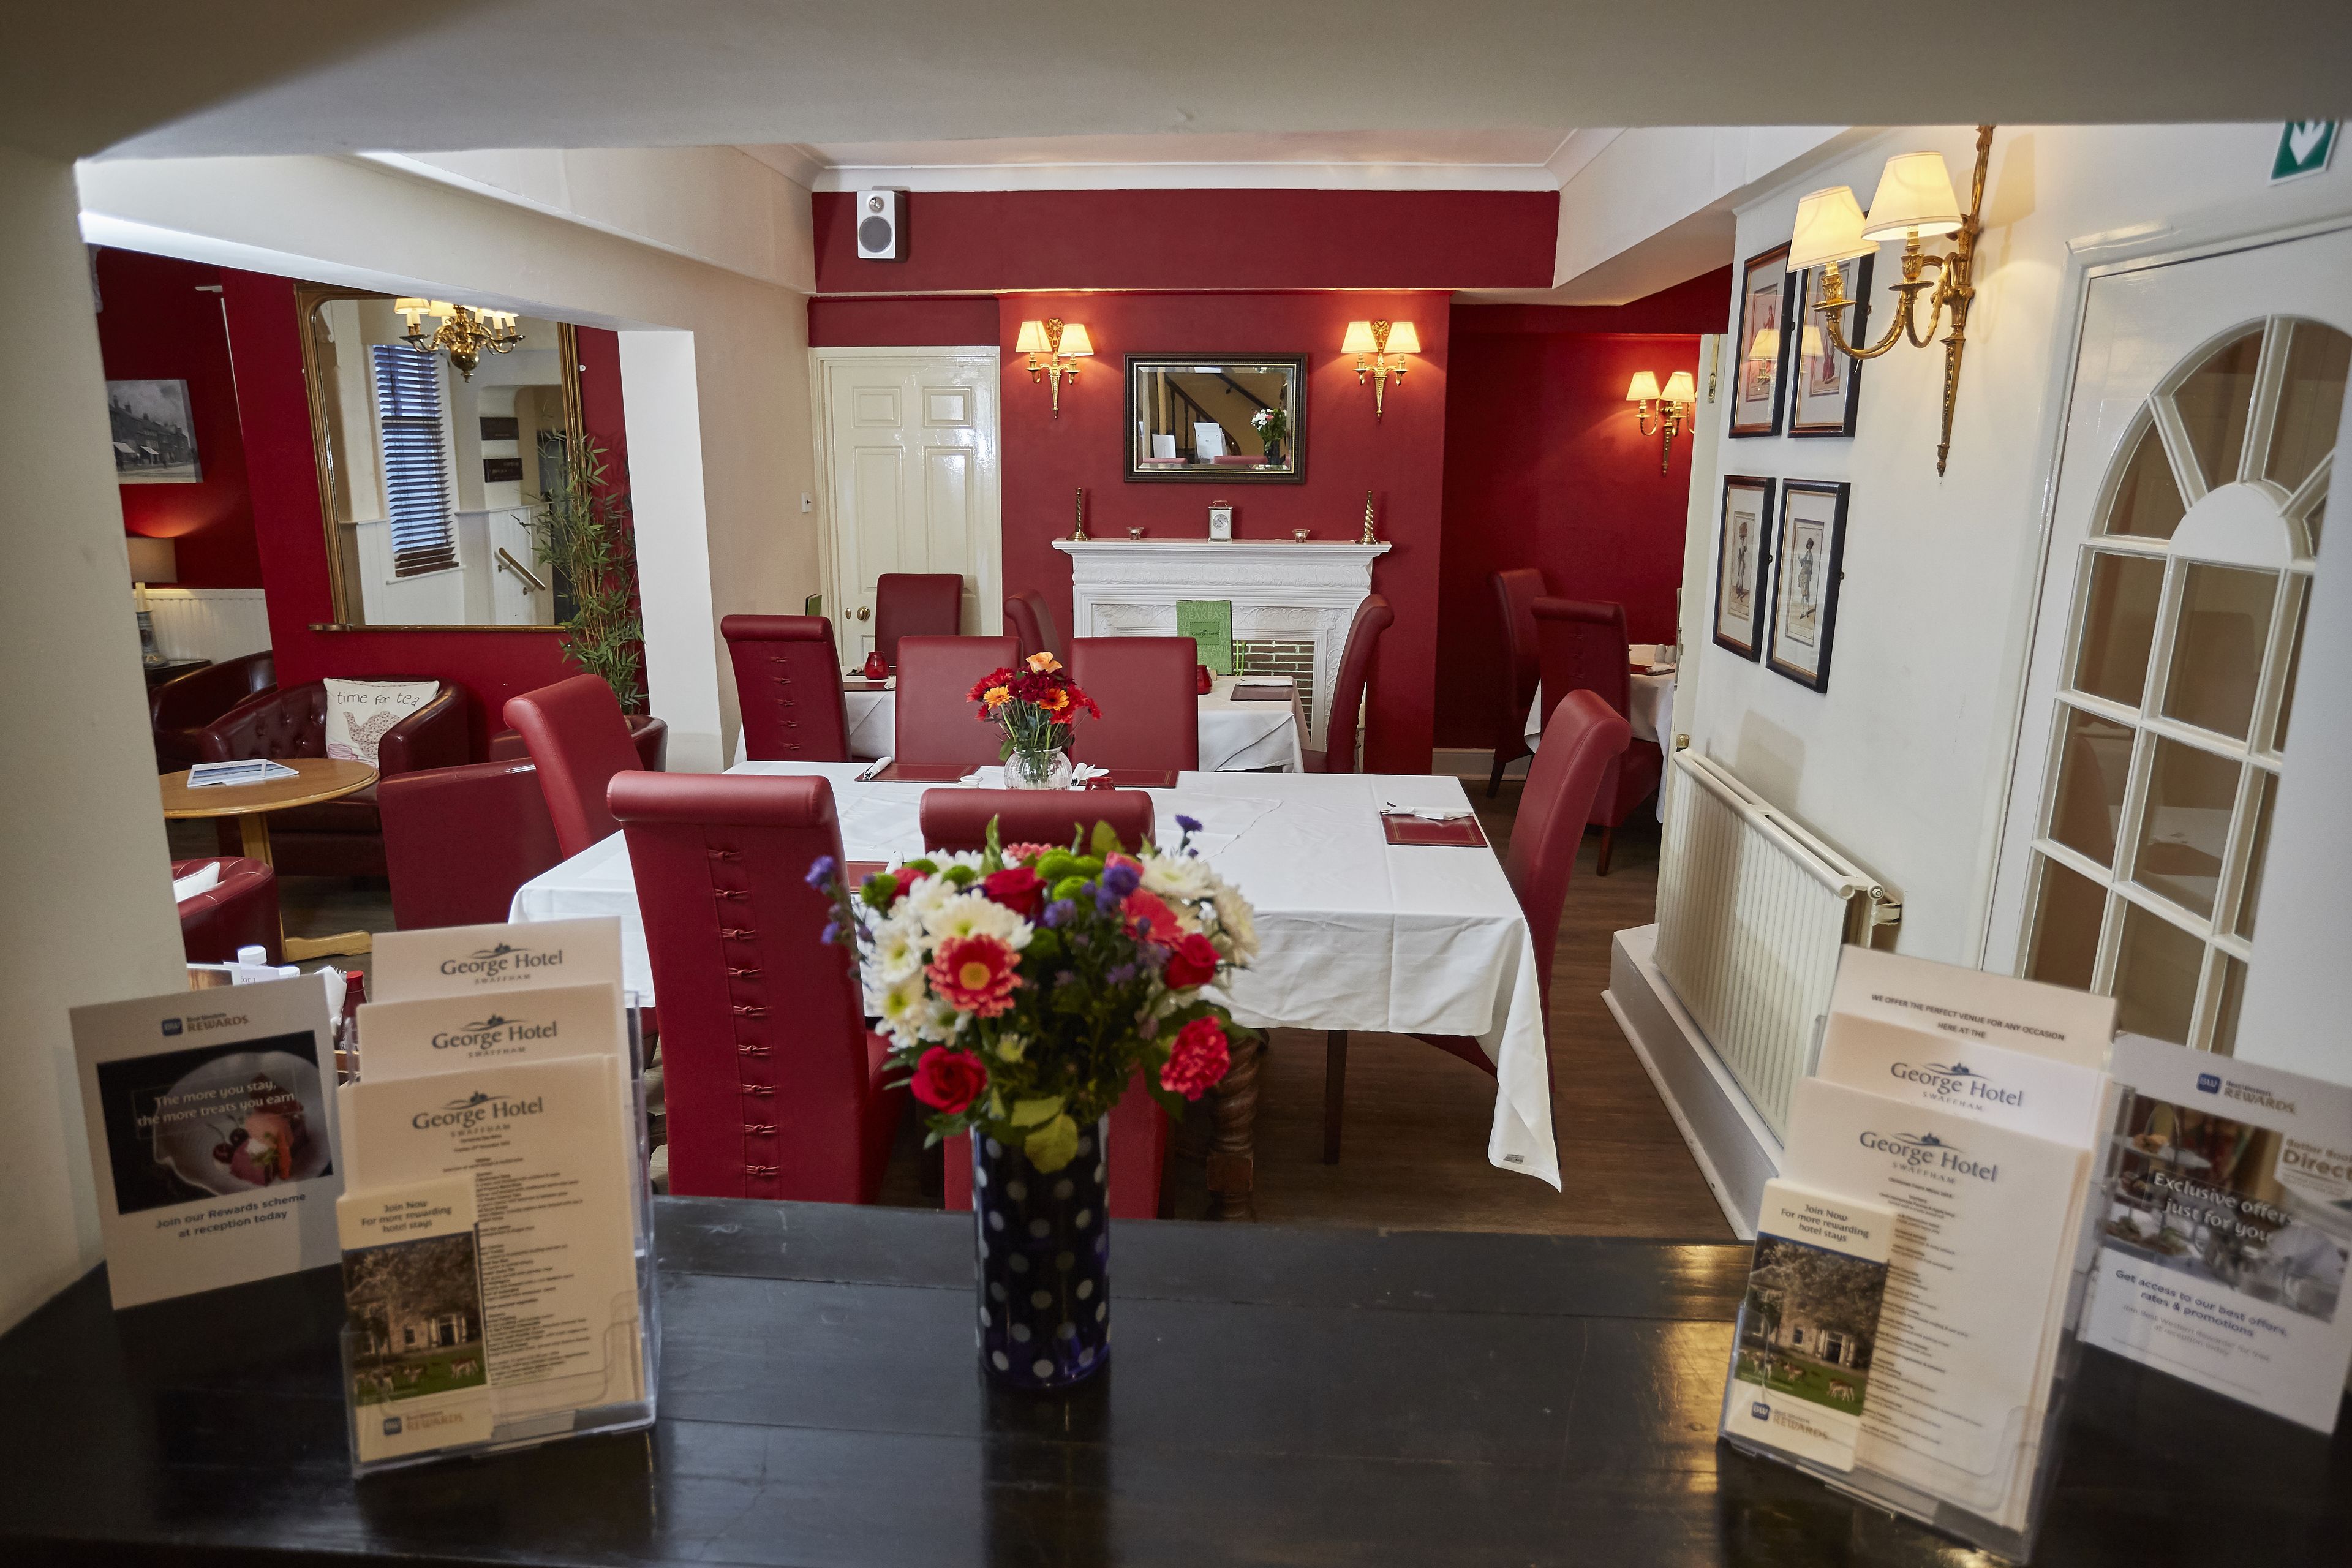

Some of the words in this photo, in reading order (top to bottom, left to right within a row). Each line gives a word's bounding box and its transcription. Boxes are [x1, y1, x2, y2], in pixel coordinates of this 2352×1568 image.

[337, 692, 368, 704] time
[375, 694, 390, 705] for
[396, 692, 420, 707] tea
[440, 959, 508, 976] George
[515, 949, 563, 968] Hotel
[475, 974, 531, 985] SWAFFHAM
[187, 1015, 249, 1032] REWARDS
[1871, 993, 1883, 1002] WE
[1885, 997, 1908, 1008] OFFER
[1910, 1002, 1924, 1011] THE
[1925, 1005, 1958, 1019] PERFECT
[1959, 1012, 1986, 1024] VENUE
[1987, 1019, 2002, 1028] FOR
[2004, 1022, 2021, 1031] ANY
[2022, 1026, 2064, 1041] OCCASION
[1937, 1022, 1956, 1033] HERE
[1972, 1030, 1986, 1039] THE
[432, 1030, 502, 1050] George
[508, 1020, 557, 1041] Hotel
[468, 1047, 526, 1058] SWAFFHAM
[155, 1095, 179, 1107] The
[183, 1090, 216, 1102] more
[219, 1086, 244, 1098] you
[247, 1080, 277, 1092] stay,
[1891, 1061, 1962, 1095] George
[1970, 1080, 2023, 1107] Hotel
[137, 1115, 160, 1127] the
[163, 1109, 197, 1122] more
[200, 1103, 237, 1117] treats
[240, 1098, 263, 1111] you
[266, 1092, 295, 1104] earn
[412, 1107, 486, 1129] George
[492, 1096, 543, 1119] Hotel
[1923, 1091, 1983, 1111] SWAFFHAM
[2223, 1087, 2296, 1115] REWARDS
[450, 1123, 511, 1138] SWAFFHAM
[1860, 1131, 1934, 1166] George
[1940, 1152, 1998, 1182] Hotel
[1892, 1162, 1955, 1184] SWAFFHAM
[156, 1218, 181, 1229] Join
[185, 1213, 205, 1223] our
[208, 1203, 259, 1219] Rewards
[262, 1194, 306, 1208] scheme
[384, 1204, 404, 1213] Join
[2154, 1172, 2237, 1208] Exclusive
[2241, 1200, 2293, 1224] offers
[178, 1229, 190, 1238] at
[194, 1218, 251, 1235] reception
[254, 1210, 288, 1224] today
[361, 1218, 376, 1226] For
[379, 1214, 402, 1223] more
[405, 1206, 452, 1219] rewarding
[383, 1223, 407, 1232] hotel
[409, 1219, 433, 1229] stays
[1781, 1208, 1795, 1218] For
[1798, 1214, 1820, 1225] more
[1823, 1220, 1869, 1239] rewarding
[1804, 1204, 1823, 1215] Join
[1826, 1209, 1847, 1222] Now
[2162, 1199, 2199, 1221] just
[2204, 1210, 2231, 1229] for
[2235, 1223, 2269, 1242] you
[1798, 1221, 1822, 1235] hotel
[1824, 1229, 1847, 1242] stays
[2116, 1269, 2136, 1283] Get
[2138, 1278, 2176, 1298] access
[2179, 1292, 2192, 1303] to
[2195, 1298, 2215, 1311] our
[2218, 1303, 2246, 1321] best
[2248, 1316, 2288, 1336] offers,
[2141, 1291, 2169, 1307] rates
[2172, 1302, 2180, 1311] &
[2183, 1306, 2255, 1338] promotions
[1773, 1414, 1828, 1439] REWARDS
